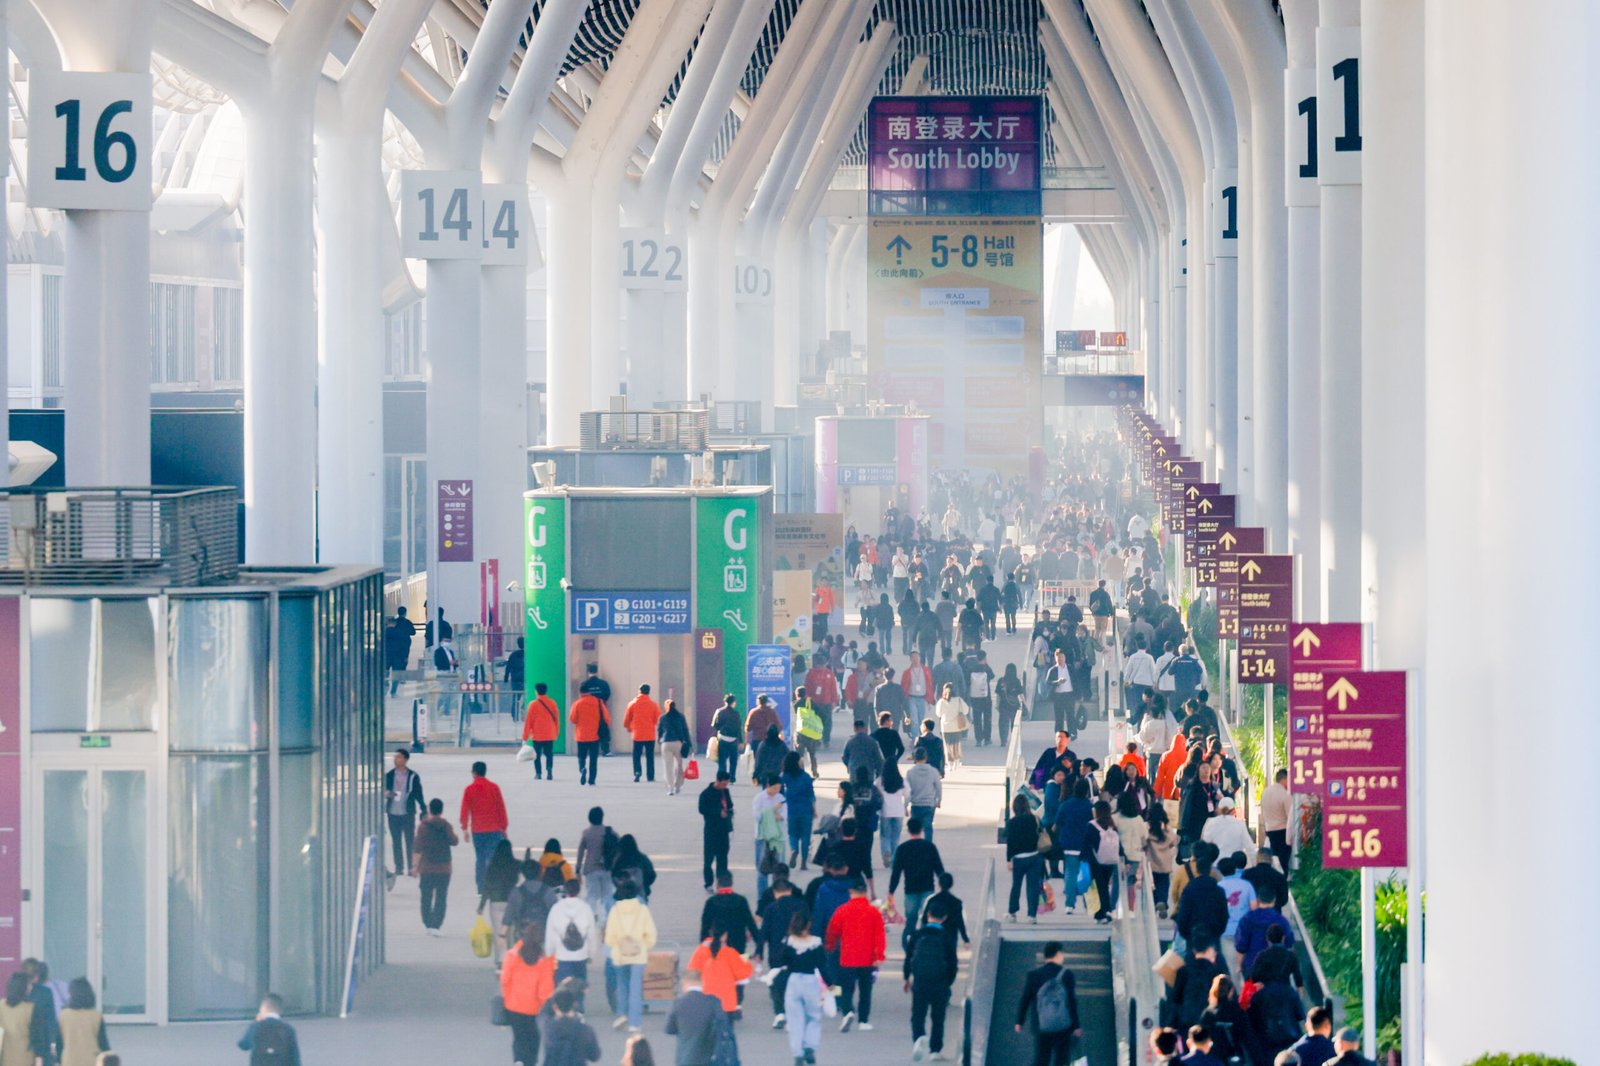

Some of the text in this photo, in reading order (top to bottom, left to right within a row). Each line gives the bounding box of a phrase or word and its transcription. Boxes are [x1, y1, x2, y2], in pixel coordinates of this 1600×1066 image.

[54, 99, 138, 183] 16
[887, 115, 1021, 141] 南登录大厅
[887, 147, 1021, 176] South Lobby
[416, 188, 473, 242] 14
[622, 239, 660, 277] 12
[931, 234, 1016, 268] 5-8 Hall
[984, 252, 1015, 267] 号馆
[528, 506, 547, 547] G
[724, 508, 747, 550] G
[585, 602, 600, 627] P
[631, 599, 657, 609] G101
[663, 599, 688, 609] G119
[631, 613, 657, 624] G201
[663, 613, 688, 624] G217
[1240, 658, 1276, 677] 1-14
[1327, 828, 1382, 858] 1-16
